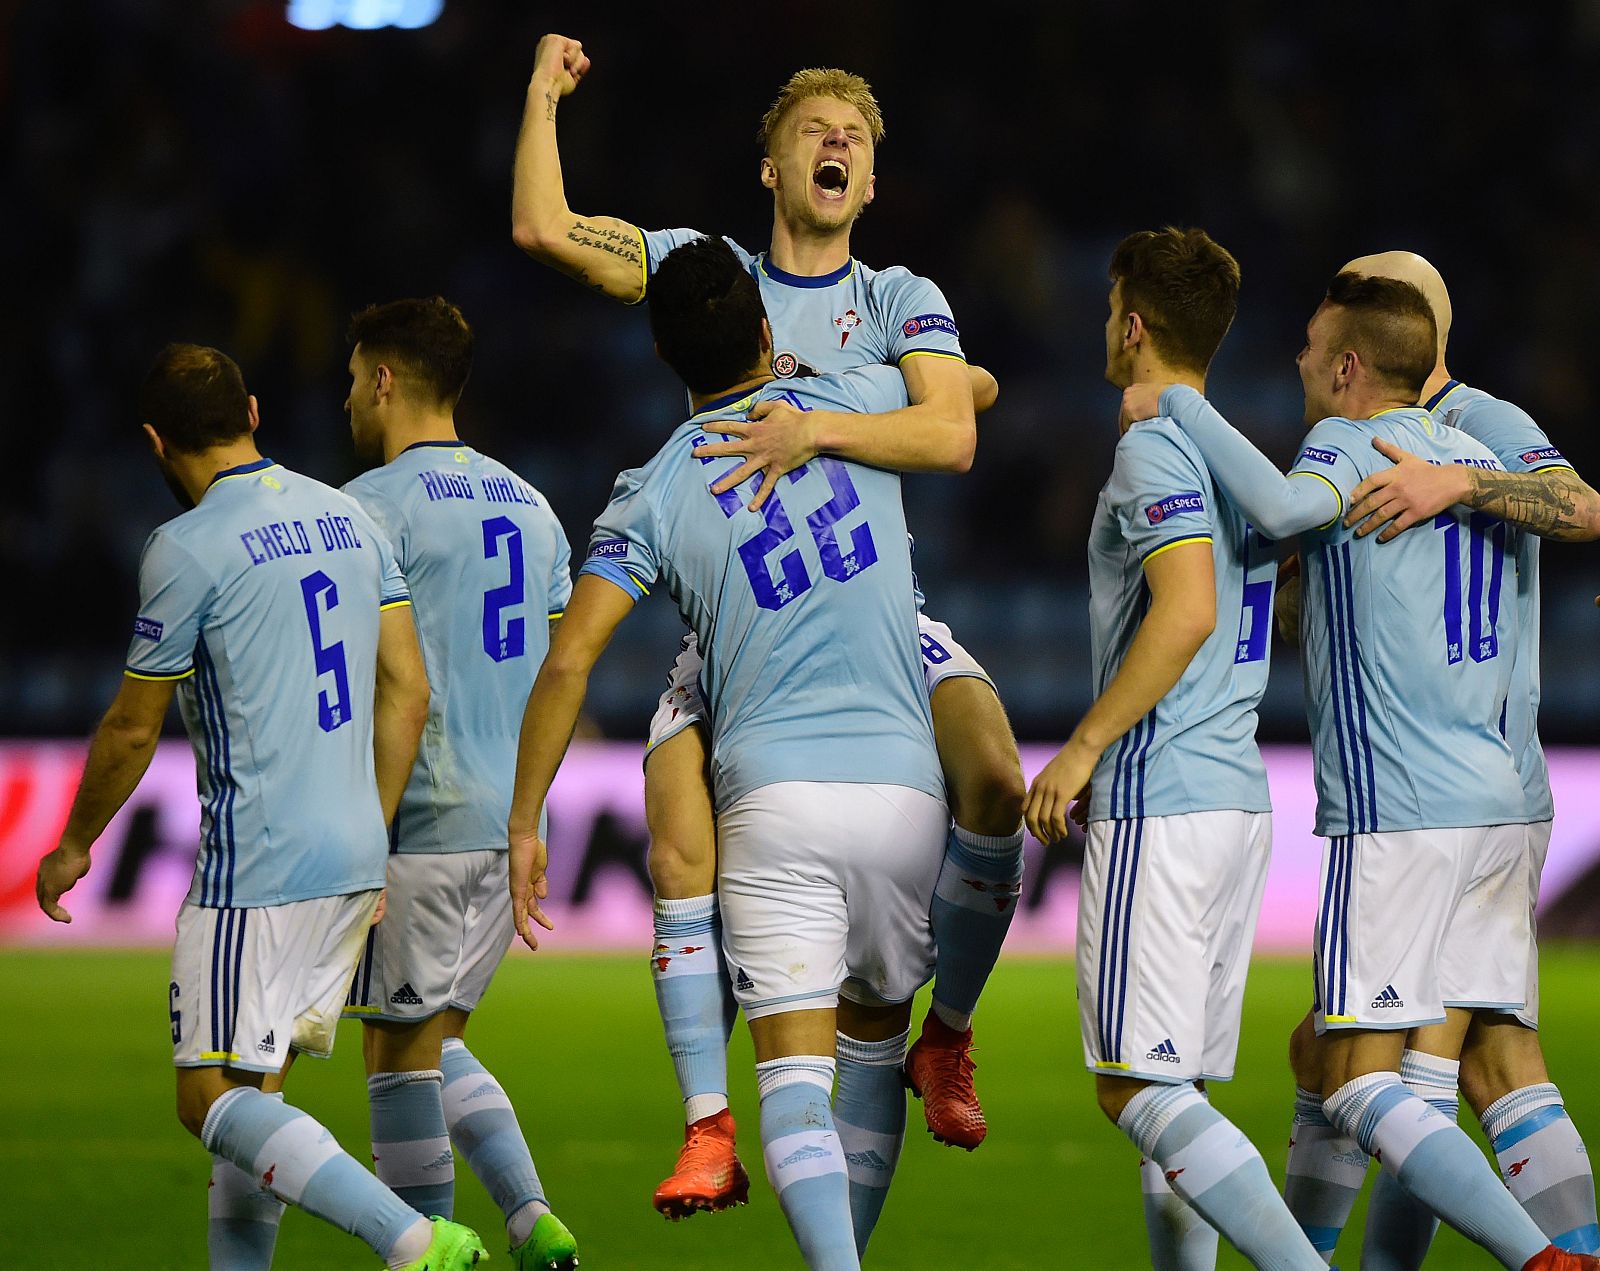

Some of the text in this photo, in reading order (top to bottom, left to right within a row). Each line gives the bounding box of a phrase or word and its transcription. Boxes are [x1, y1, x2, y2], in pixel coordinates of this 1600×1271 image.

[1303, 448, 1336, 463] SPECT
[1162, 497, 1202, 513] RESPECT
[240, 520, 312, 566] CHELO
[708, 456, 879, 611] 22
[482, 515, 525, 662] 2
[1434, 511, 1506, 666] 10
[300, 569, 352, 733] 5
[1371, 999, 1404, 1009] adidas
[1146, 1051, 1181, 1064] adidas
